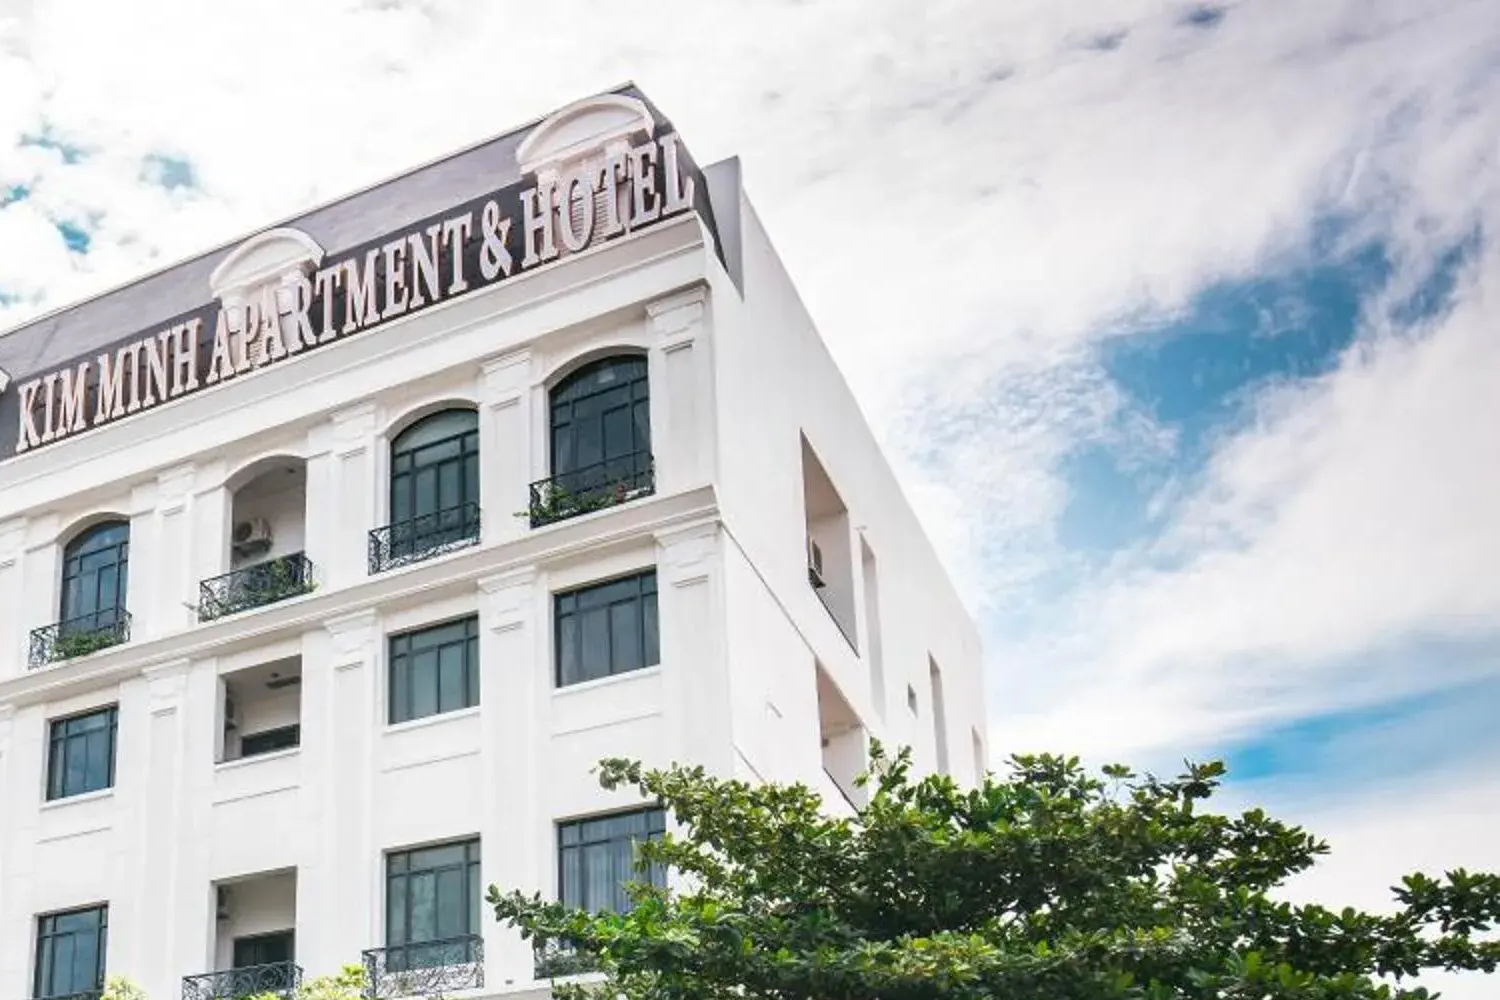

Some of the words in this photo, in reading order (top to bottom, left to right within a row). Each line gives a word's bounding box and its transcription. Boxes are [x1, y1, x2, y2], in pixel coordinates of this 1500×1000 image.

[16, 361, 91, 452] KIM
[94, 317, 202, 424] MINH
[206, 211, 473, 384] APARTMENT
[479, 200, 513, 281] &
[520, 133, 695, 269] HOTEL
